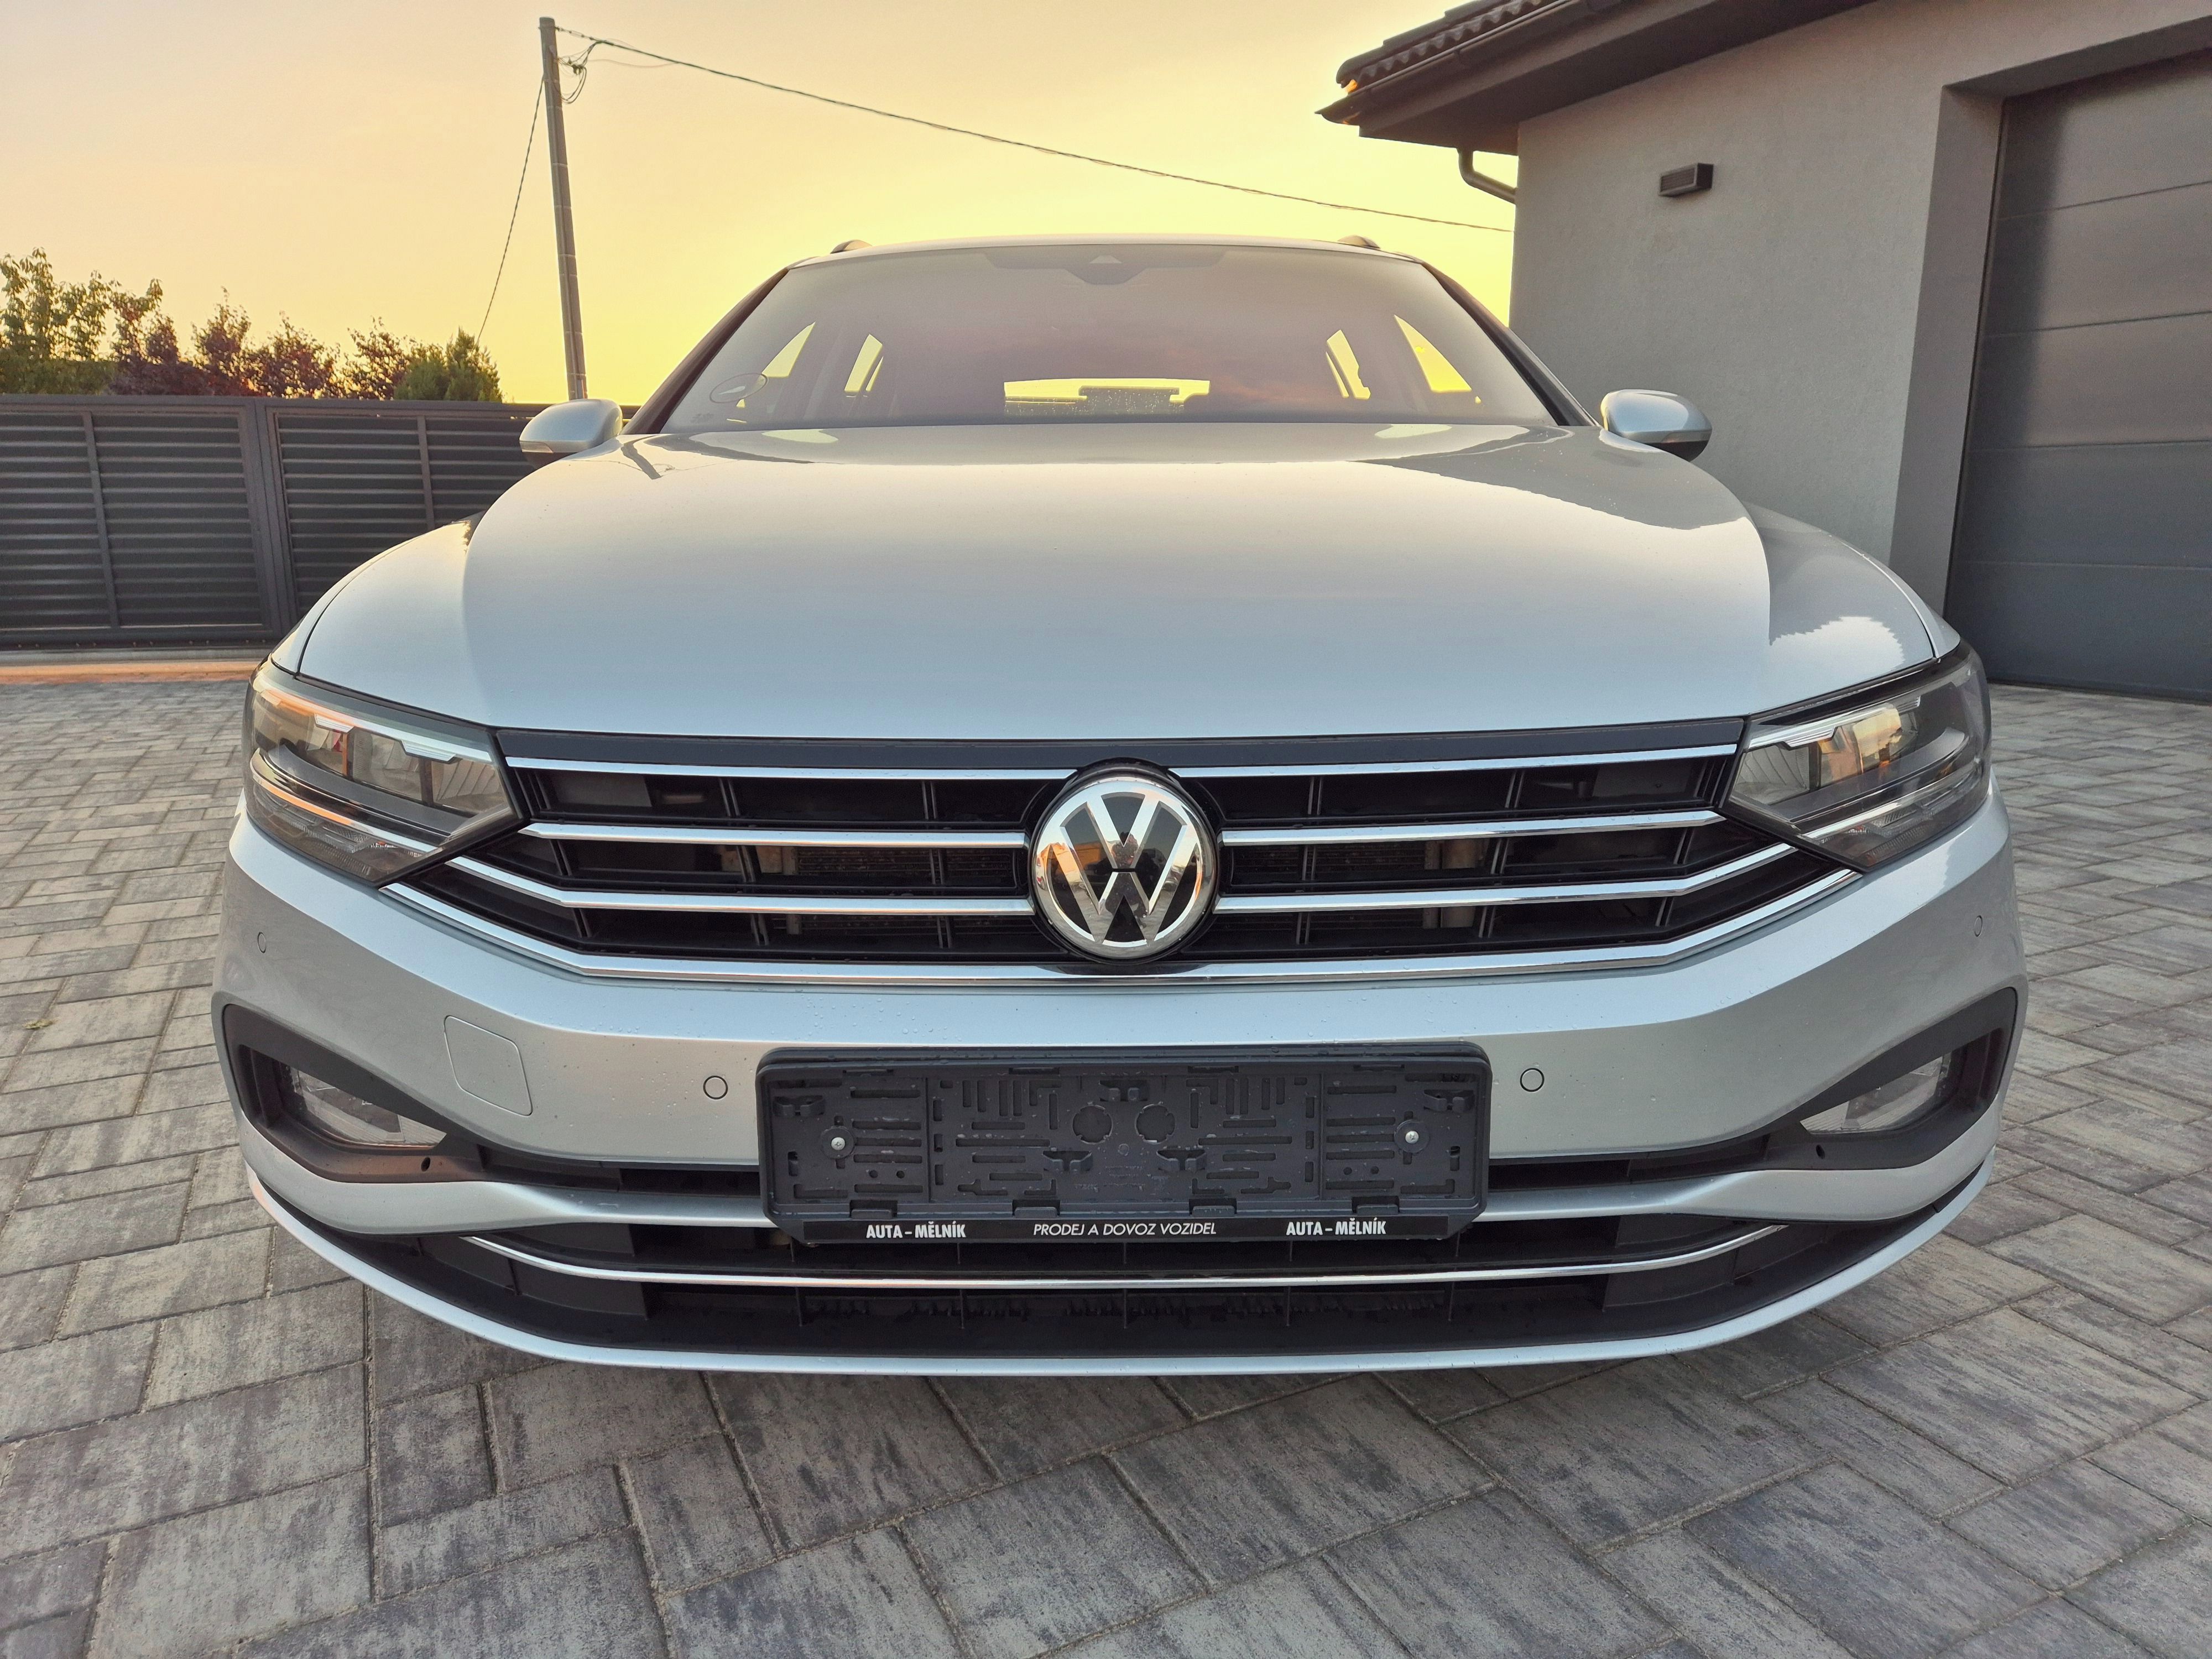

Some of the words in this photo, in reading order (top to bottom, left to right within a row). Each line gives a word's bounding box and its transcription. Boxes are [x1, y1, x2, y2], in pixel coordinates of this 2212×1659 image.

[1037, 781, 1204, 952] VW
[866, 1224, 903, 1239] AUTA
[915, 1220, 966, 1238] MĚLNÍK
[1033, 1223, 1085, 1236] PRODEJ
[1087, 1224, 1099, 1235] A
[1103, 1223, 1157, 1235] DOVOZ
[1160, 1222, 1217, 1235] VOZIDEL
[1286, 1222, 1323, 1235] AUTA
[1335, 1217, 1386, 1235] MĚLNÍK
